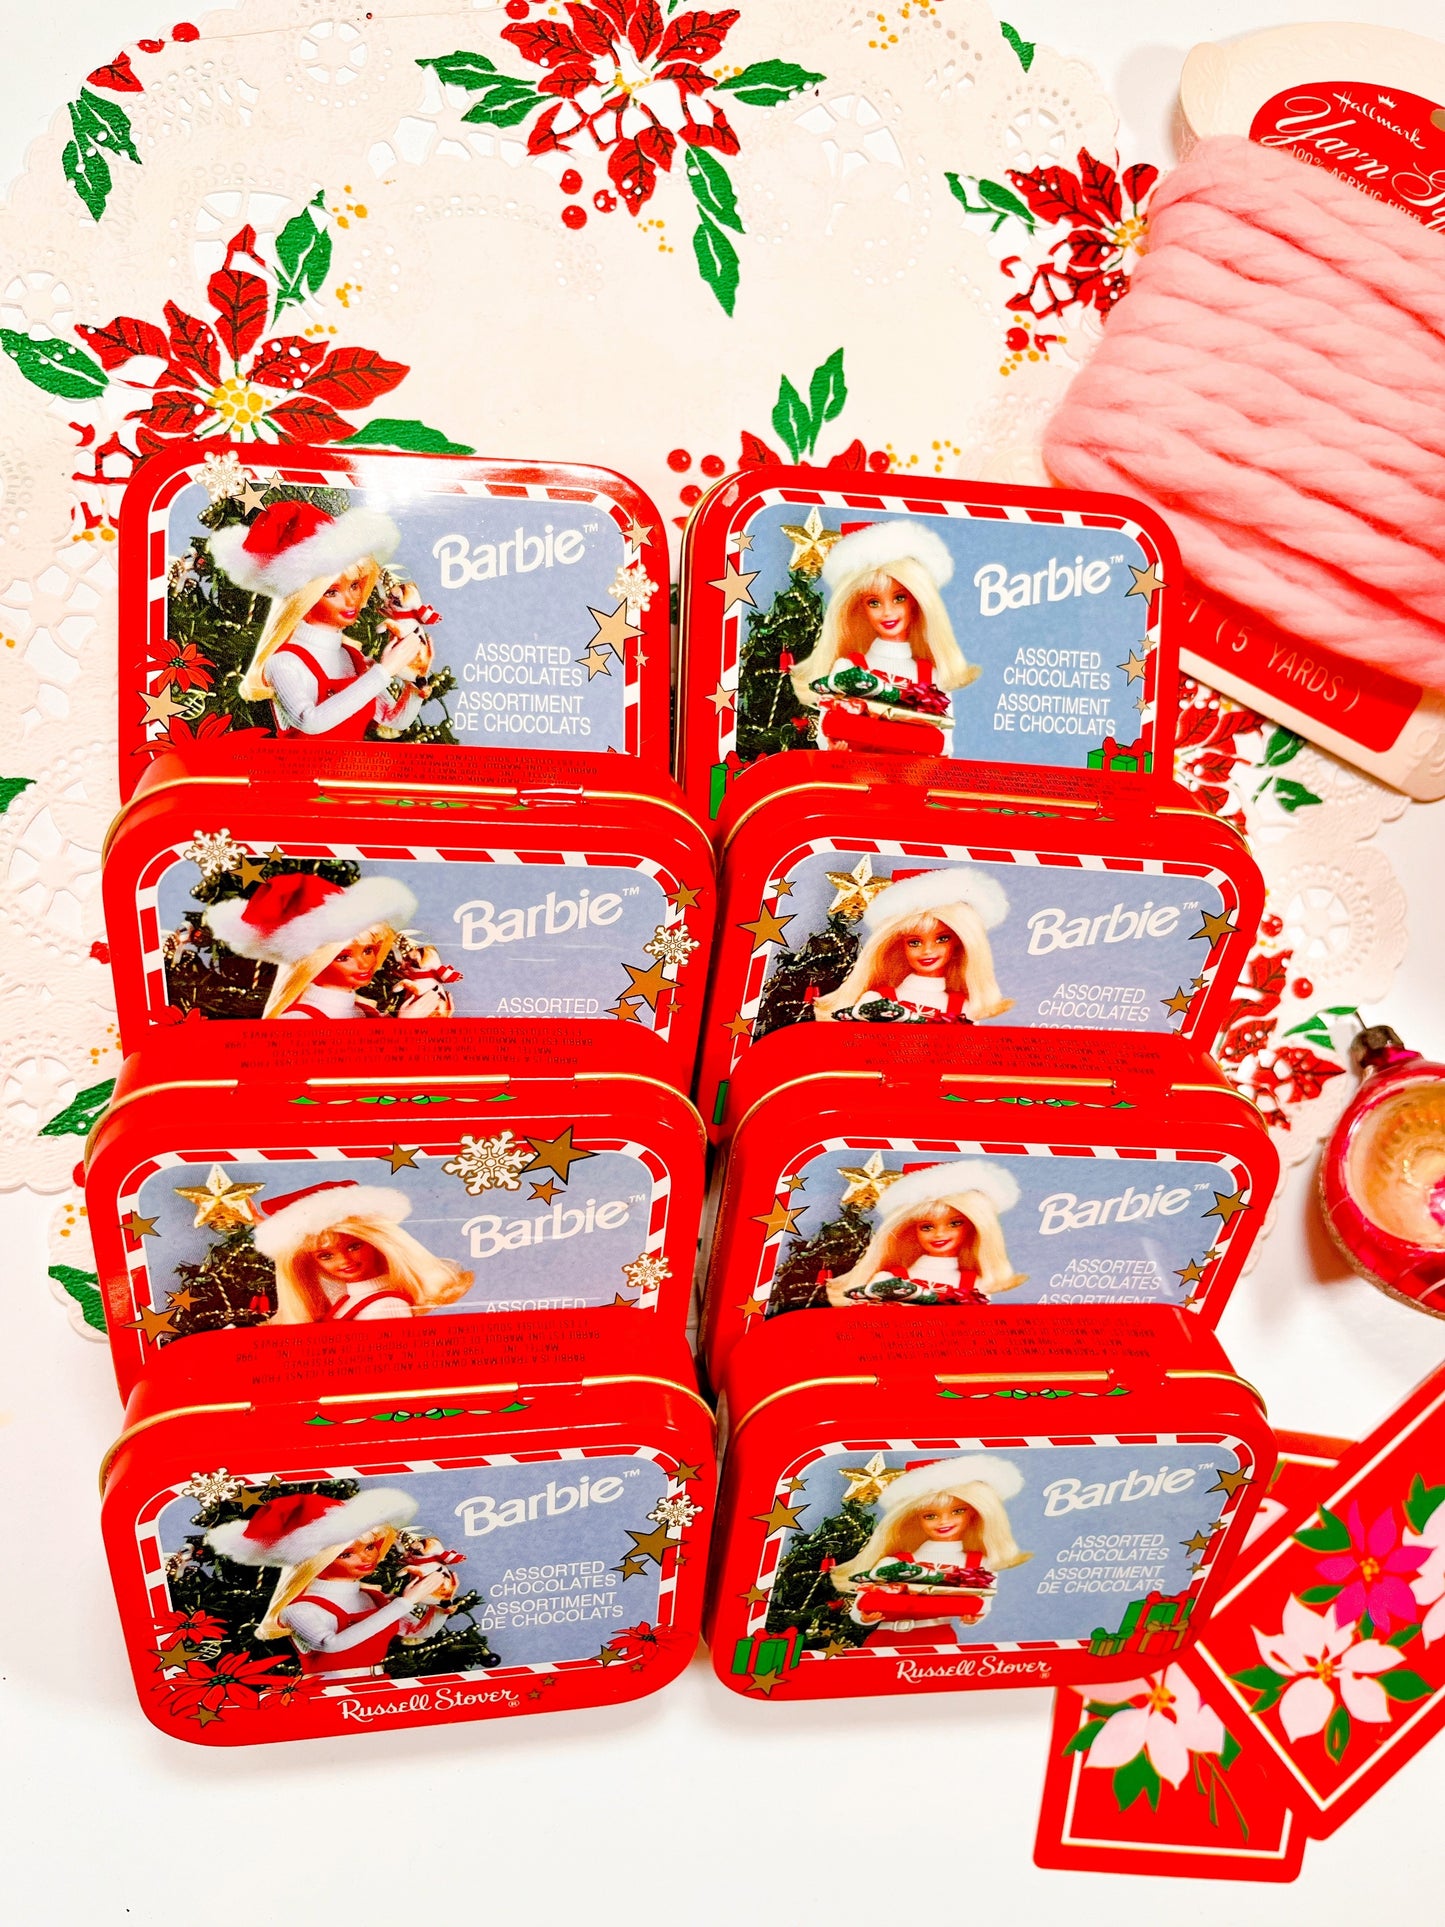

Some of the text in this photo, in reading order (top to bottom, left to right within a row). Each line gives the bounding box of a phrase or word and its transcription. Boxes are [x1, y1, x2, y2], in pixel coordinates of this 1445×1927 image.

[1333, 91, 1426, 149] Hallmark
[1261, 96, 1389, 180] Yarn
[432, 524, 586, 589] Barbie
[974, 555, 1111, 617] Barbie
[475, 643, 571, 665] ASSORTED
[1014, 648, 1101, 669] ASSORTED
[463, 664, 582, 687] CHOCOLATES
[1003, 667, 1110, 691] CHOCOLATES
[457, 692, 584, 714] ASSORTIMENT
[997, 693, 1110, 716] ASSORTIMENT
[454, 713, 591, 736] DE CHOCOLATS
[993, 713, 1116, 737] DE CHOCOLATS
[453, 888, 623, 951] Barbie
[1027, 901, 1181, 956] Barbie
[1053, 983, 1146, 1004] ASSORTED
[496, 998, 599, 1015] ASSORTED
[1038, 1001, 1150, 1022] CHOCOLATES
[1038, 1183, 1192, 1235] Barbie
[461, 1198, 629, 1259] Barbie
[1065, 1258, 1157, 1274] ASSORTED
[1050, 1274, 1162, 1290] CHOCOLATES
[1043, 1465, 1196, 1517] Barbie
[454, 1475, 625, 1537] Barbie
[1072, 1534, 1164, 1549] ASSORTED
[1056, 1548, 1170, 1563] CHOCOLATES
[502, 1561, 605, 1582] ASSORTED
[1044, 1565, 1165, 1580] ASSORTIMENT
[489, 1574, 616, 1598] CHOCOLATES
[1036, 1579, 1165, 1594] DE CHOCOLATS
[483, 1592, 617, 1617] ASSORTIMENT
[481, 1605, 624, 1631] DE CHOCOLATS
[896, 1655, 1052, 1684] Russell Stover
[337, 1687, 520, 1723] Russell Stover
